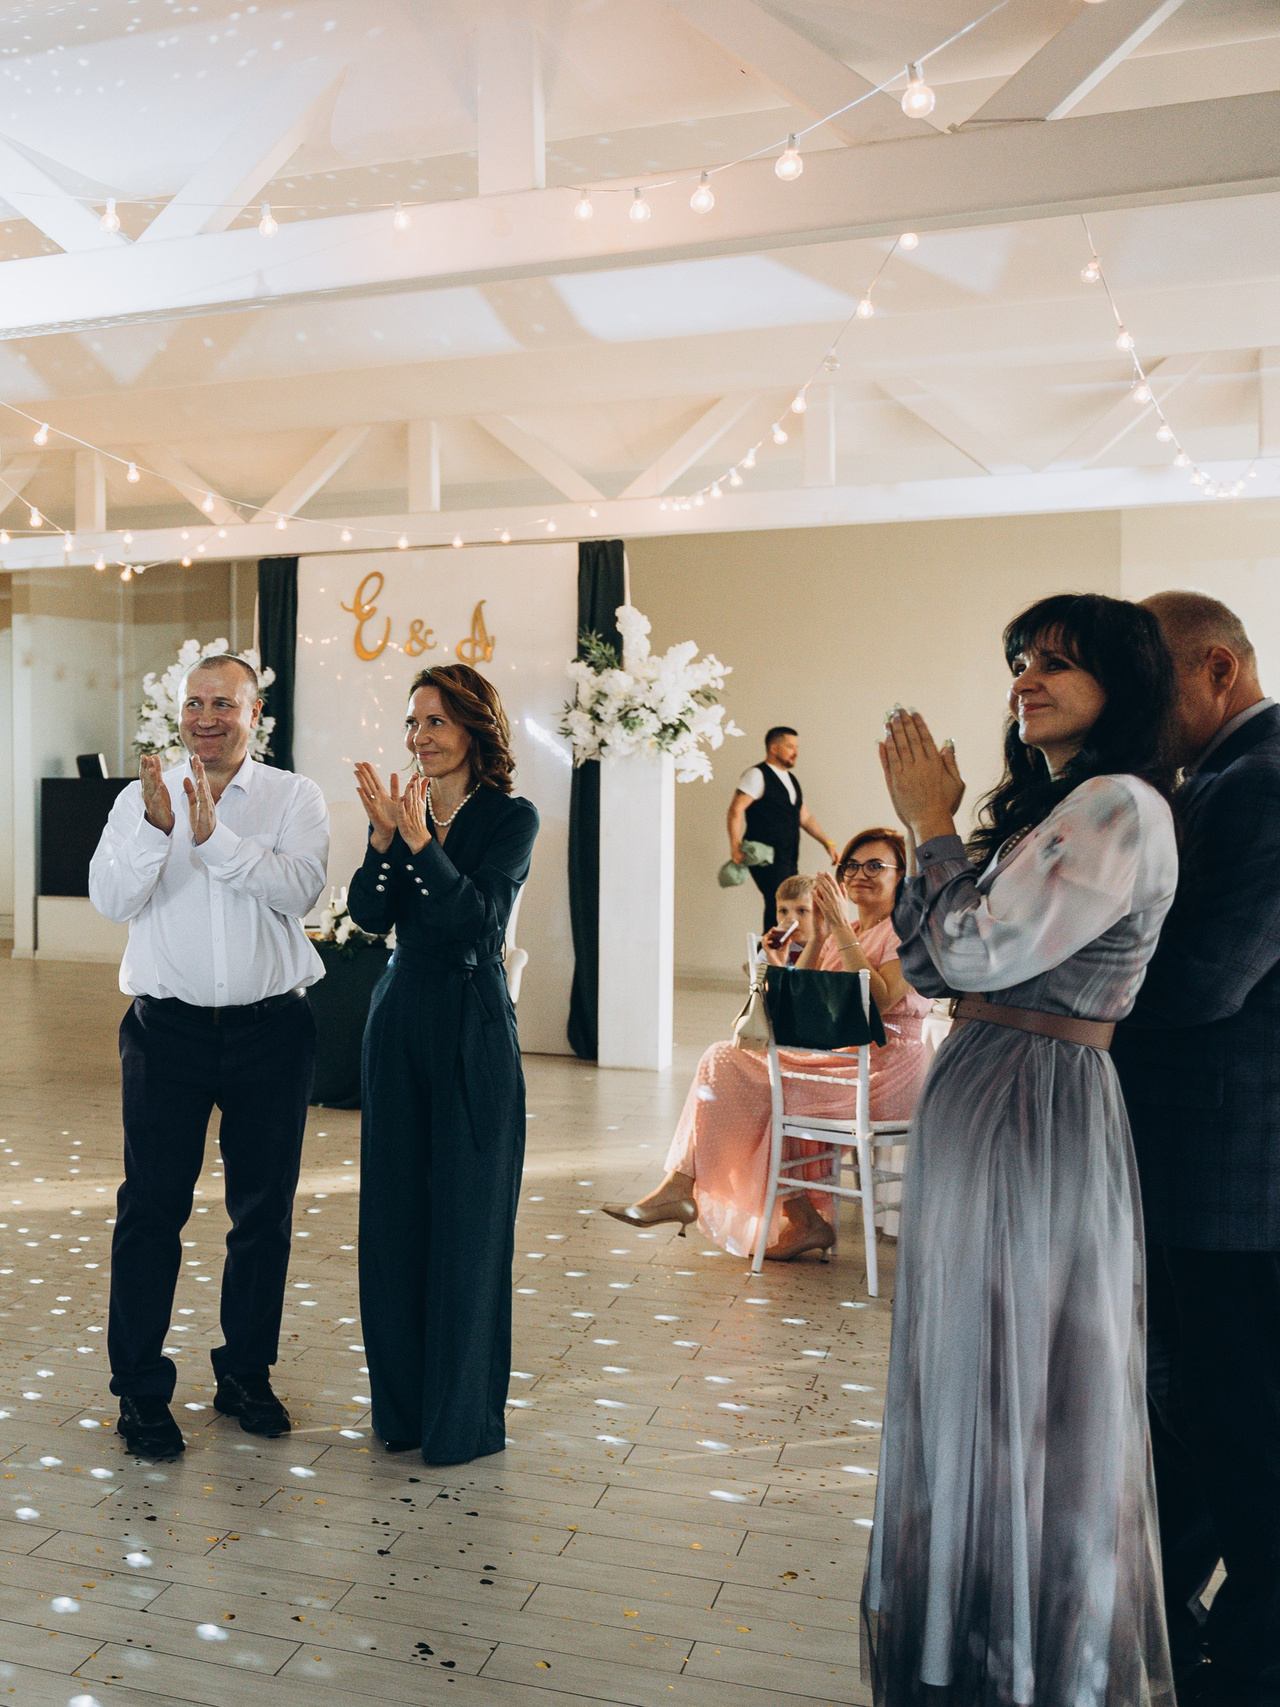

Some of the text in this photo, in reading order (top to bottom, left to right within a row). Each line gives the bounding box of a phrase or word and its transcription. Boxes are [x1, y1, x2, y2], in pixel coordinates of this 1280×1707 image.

[340, 571, 496, 668] E & A
